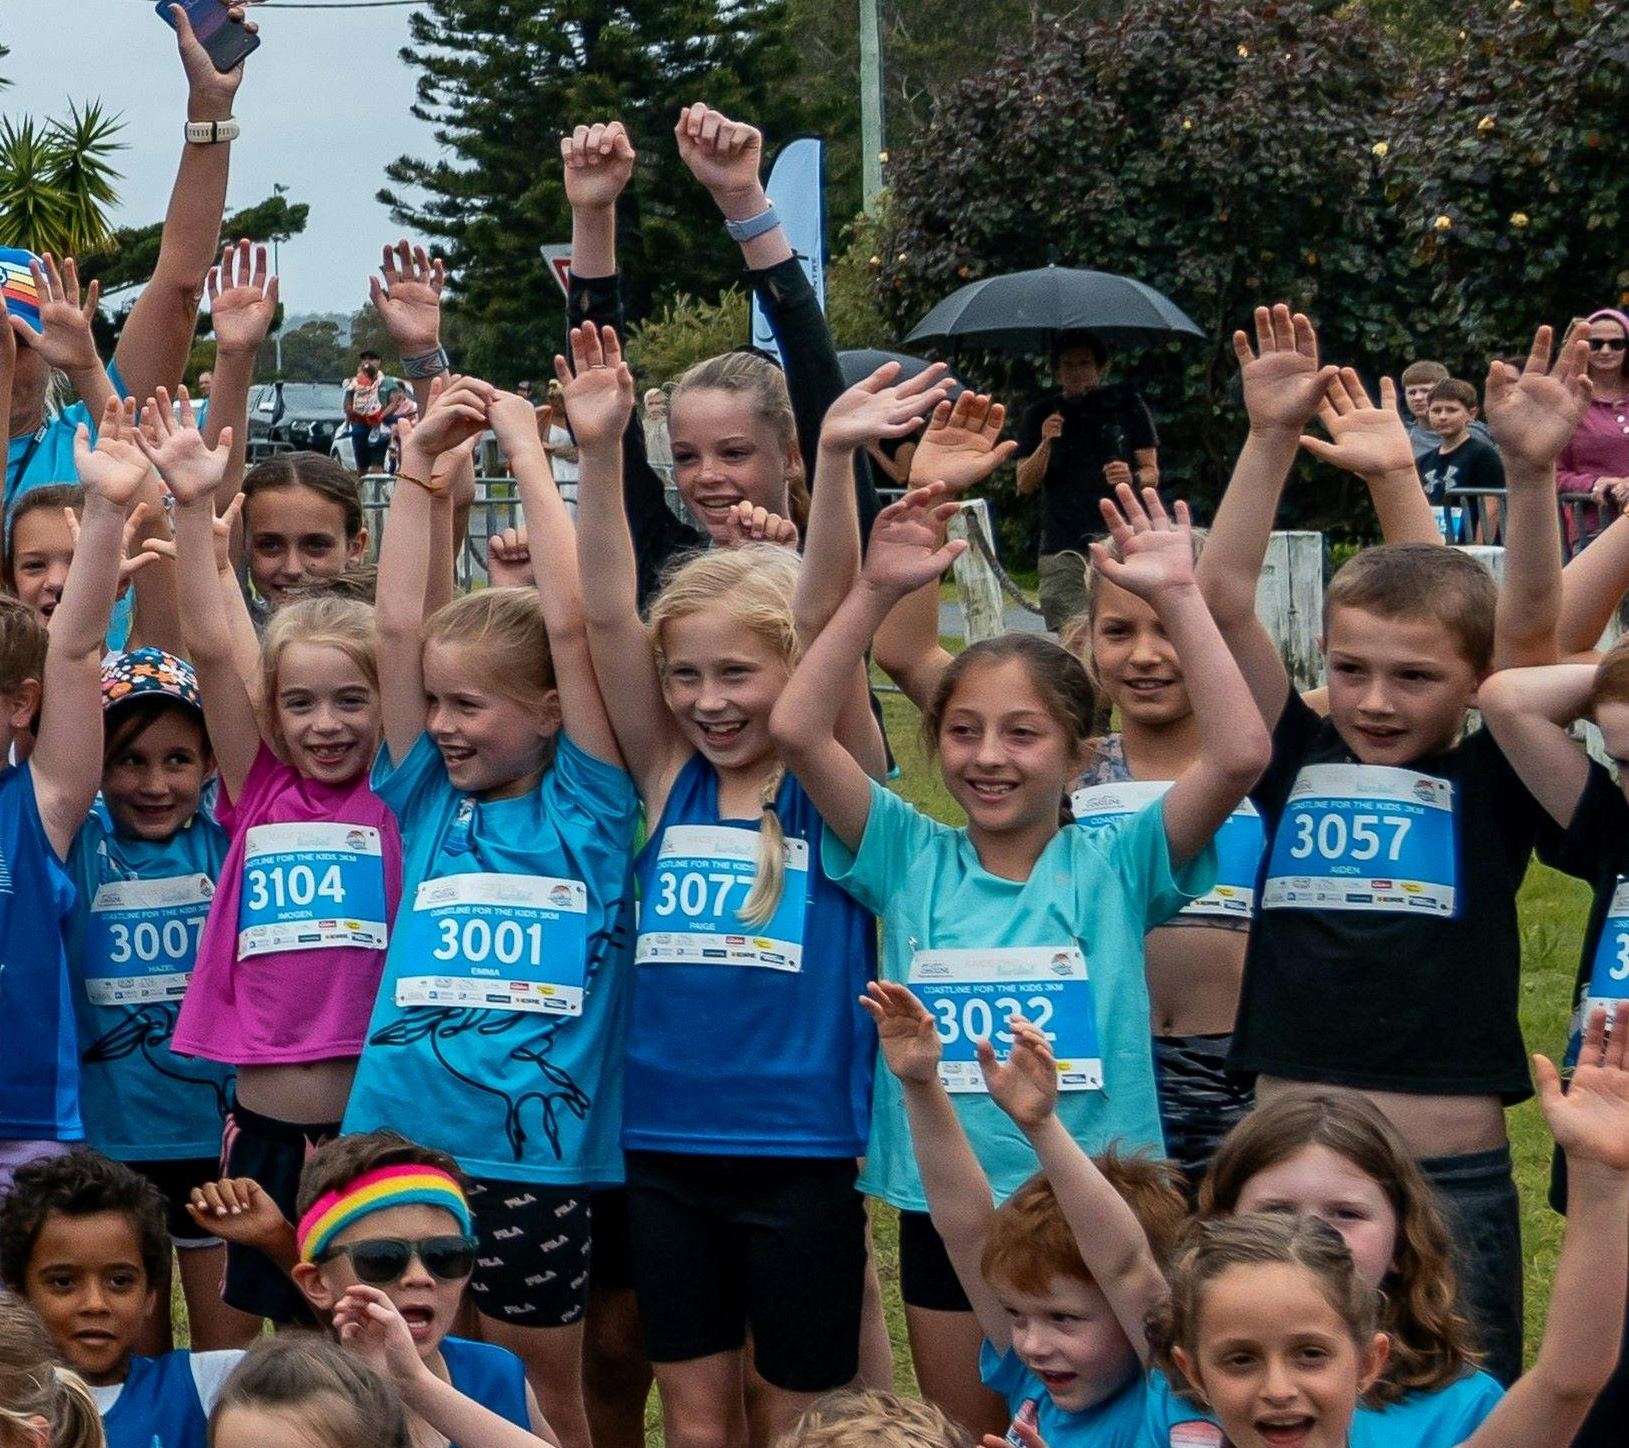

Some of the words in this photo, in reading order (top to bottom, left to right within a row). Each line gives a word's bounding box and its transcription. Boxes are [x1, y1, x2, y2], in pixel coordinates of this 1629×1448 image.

[1291, 813, 1411, 860] 3057
[249, 865, 346, 910] 3104
[433, 918, 541, 965] 3001
[974, 985, 994, 993] FOR
[932, 996, 1056, 1044] 3032
